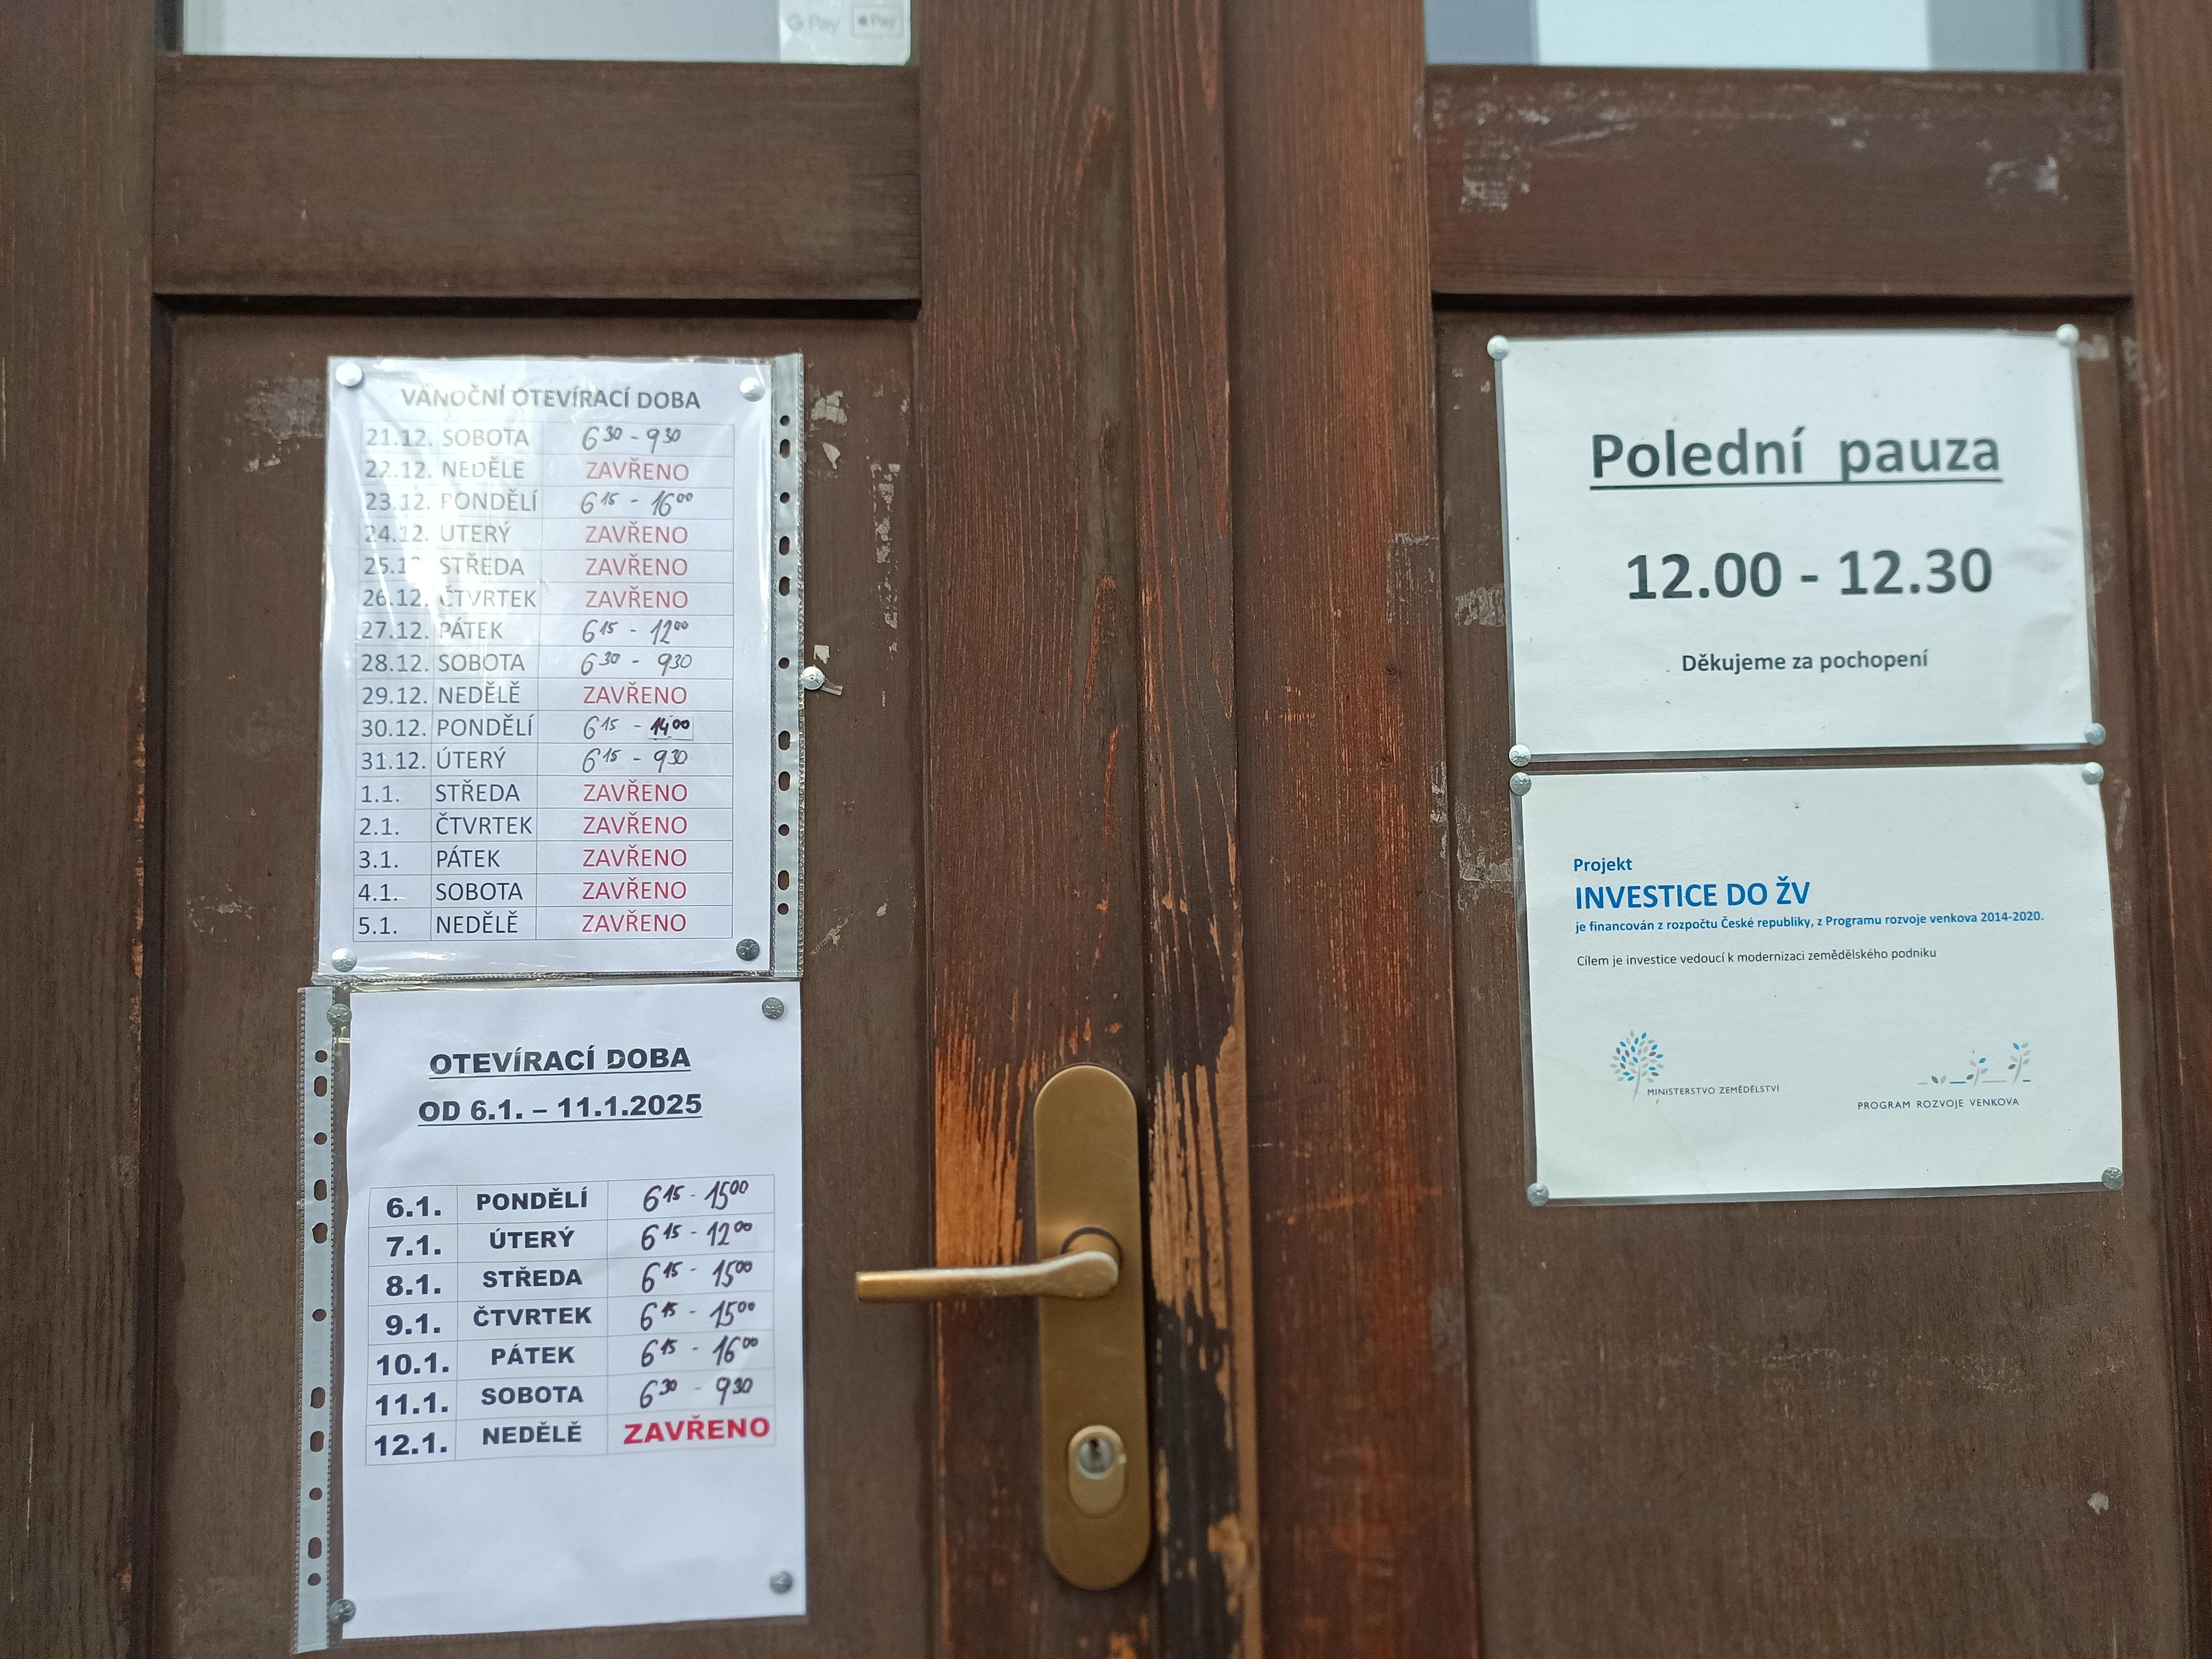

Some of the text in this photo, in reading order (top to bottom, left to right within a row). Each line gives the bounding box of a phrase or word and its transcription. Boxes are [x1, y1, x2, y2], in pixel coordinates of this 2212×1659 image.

[513, 386, 630, 408] OTEVÍRACÍ
[638, 392, 701, 409] DOBA
[366, 429, 432, 446] 21.12.
[443, 429, 529, 446] SOBOTA
[1591, 425, 2001, 482] Polední pauza
[366, 460, 432, 478] 22.12.
[587, 457, 689, 481] ZAVŘENO
[366, 492, 430, 510] 23.12.
[441, 488, 538, 511] PONDĚLÍ
[586, 521, 688, 544] ZAVŘENO
[440, 552, 525, 575] STŘEDA
[586, 553, 688, 576] ZAVŘENO
[1627, 551, 1782, 600] 12.00
[1839, 547, 1992, 596] 12.30
[363, 585, 688, 608] 26.12. ČTVRTEK ZAVŘENO
[362, 621, 429, 639] 27.12.
[440, 617, 503, 639] PÁTEK
[362, 654, 429, 672] 28.12.
[439, 654, 525, 672] SOBOTA
[1682, 649, 1928, 675] Děkujeme za pochopení
[362, 681, 687, 705] 29.12. NEDĚLĚ ZAVŘENO
[362, 719, 426, 737] 30.12.
[437, 713, 534, 736] PONDĚLÍ
[361, 752, 426, 770] 31.12.
[437, 746, 506, 769] ÚTERÝ
[361, 779, 687, 802] 1.1. STŘEDA ZAVŘENO
[359, 811, 687, 836] 2.1. ČTVRTEK ZAVŘENO
[359, 844, 687, 869] 3.1. PÁTEK ZAVŘENO
[1574, 857, 1632, 874] Projekt
[358, 877, 686, 901] 4.1. SOBOTA ZAVŘENO
[1576, 876, 1811, 909] INVESTICE DO ŽV
[358, 909, 686, 935] 5.1. NEDĚLĚ ZAVŘENO
[1575, 921, 1586, 934] je
[1589, 919, 1654, 932] financován
[1667, 918, 1718, 932] rozpočtu
[1721, 916, 1754, 928] České
[1757, 916, 1814, 929] republiky,
[1826, 916, 1881, 928] Programu
[1885, 914, 1927, 926] rozvoje
[1929, 914, 1978, 923] venkova
[1980, 911, 2044, 922] 2014-2020.
[1577, 947, 1936, 967] Cílem je investice vedoucí k modernizaci zemědělského podniku
[429, 1045, 691, 1075] OTEVÍRACÍ DOBA
[1647, 1087, 1715, 1096] MINISTERSTVO
[1858, 1097, 2020, 1110] PROGRAM ROZVOJE VENKOVA
[419, 1100, 461, 1122] OD
[470, 1099, 523, 1121] 6.1.
[558, 1093, 702, 1117] 11.1.2025
[387, 1196, 441, 1218] 6.1.
[477, 1187, 588, 1211] PONDĚLÍ
[387, 1235, 441, 1256] 7.1.
[490, 1226, 575, 1249] ÚTERÝ
[386, 1274, 441, 1296] 8.1.
[482, 1265, 583, 1287] STŘEDA
[385, 1313, 441, 1336] 9.1.
[473, 1305, 592, 1327] ČTVRTEK
[377, 1352, 449, 1375] 10.1.
[491, 1343, 575, 1365] PÁTEK
[375, 1392, 448, 1416] 11.1.
[482, 1386, 583, 1405] SOBOTA
[375, 1415, 770, 1457] 12.1. NEDĚLĚ ZAVŘENO
